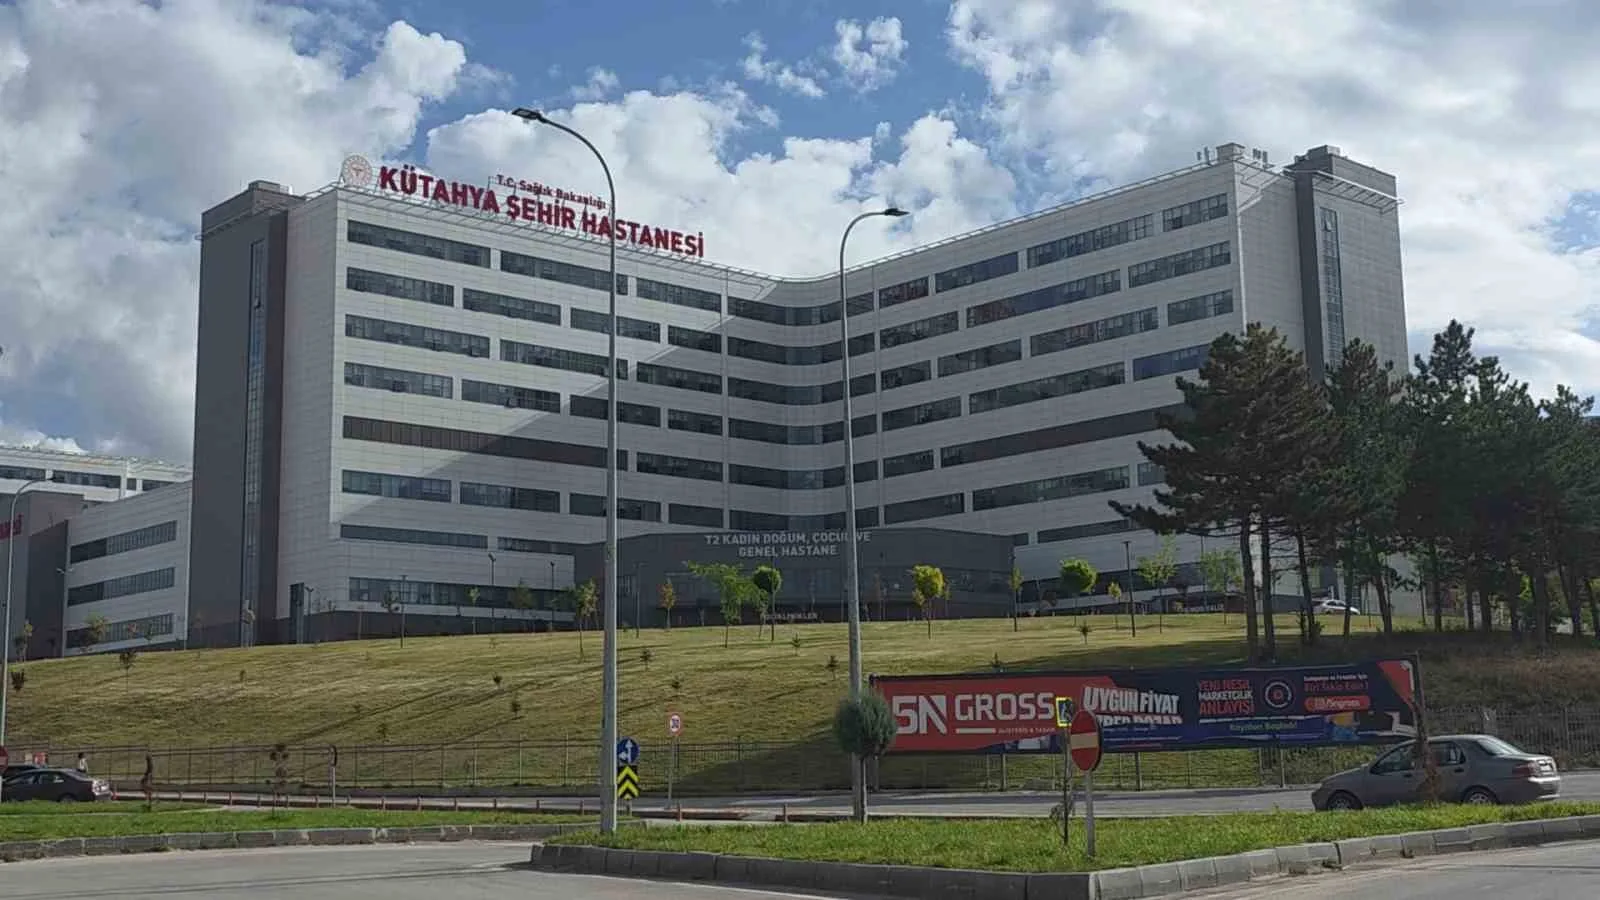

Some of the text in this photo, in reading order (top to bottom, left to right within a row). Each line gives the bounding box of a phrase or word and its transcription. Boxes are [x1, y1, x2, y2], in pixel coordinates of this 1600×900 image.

[496, 174, 606, 210] T.C. Sağlık Bakanlığı
[379, 164, 704, 258] KÜTAHYA ŞEHİR HASTANESİ
[704, 534, 720, 545] T2
[722, 533, 761, 545] KADIN
[763, 530, 810, 545] DOĞUM,
[856, 531, 872, 542] VE
[738, 544, 839, 558] GENEL HASTANE
[954, 692, 1055, 721] GROSS
[1083, 687, 1180, 714] UYGUN FİYAT
